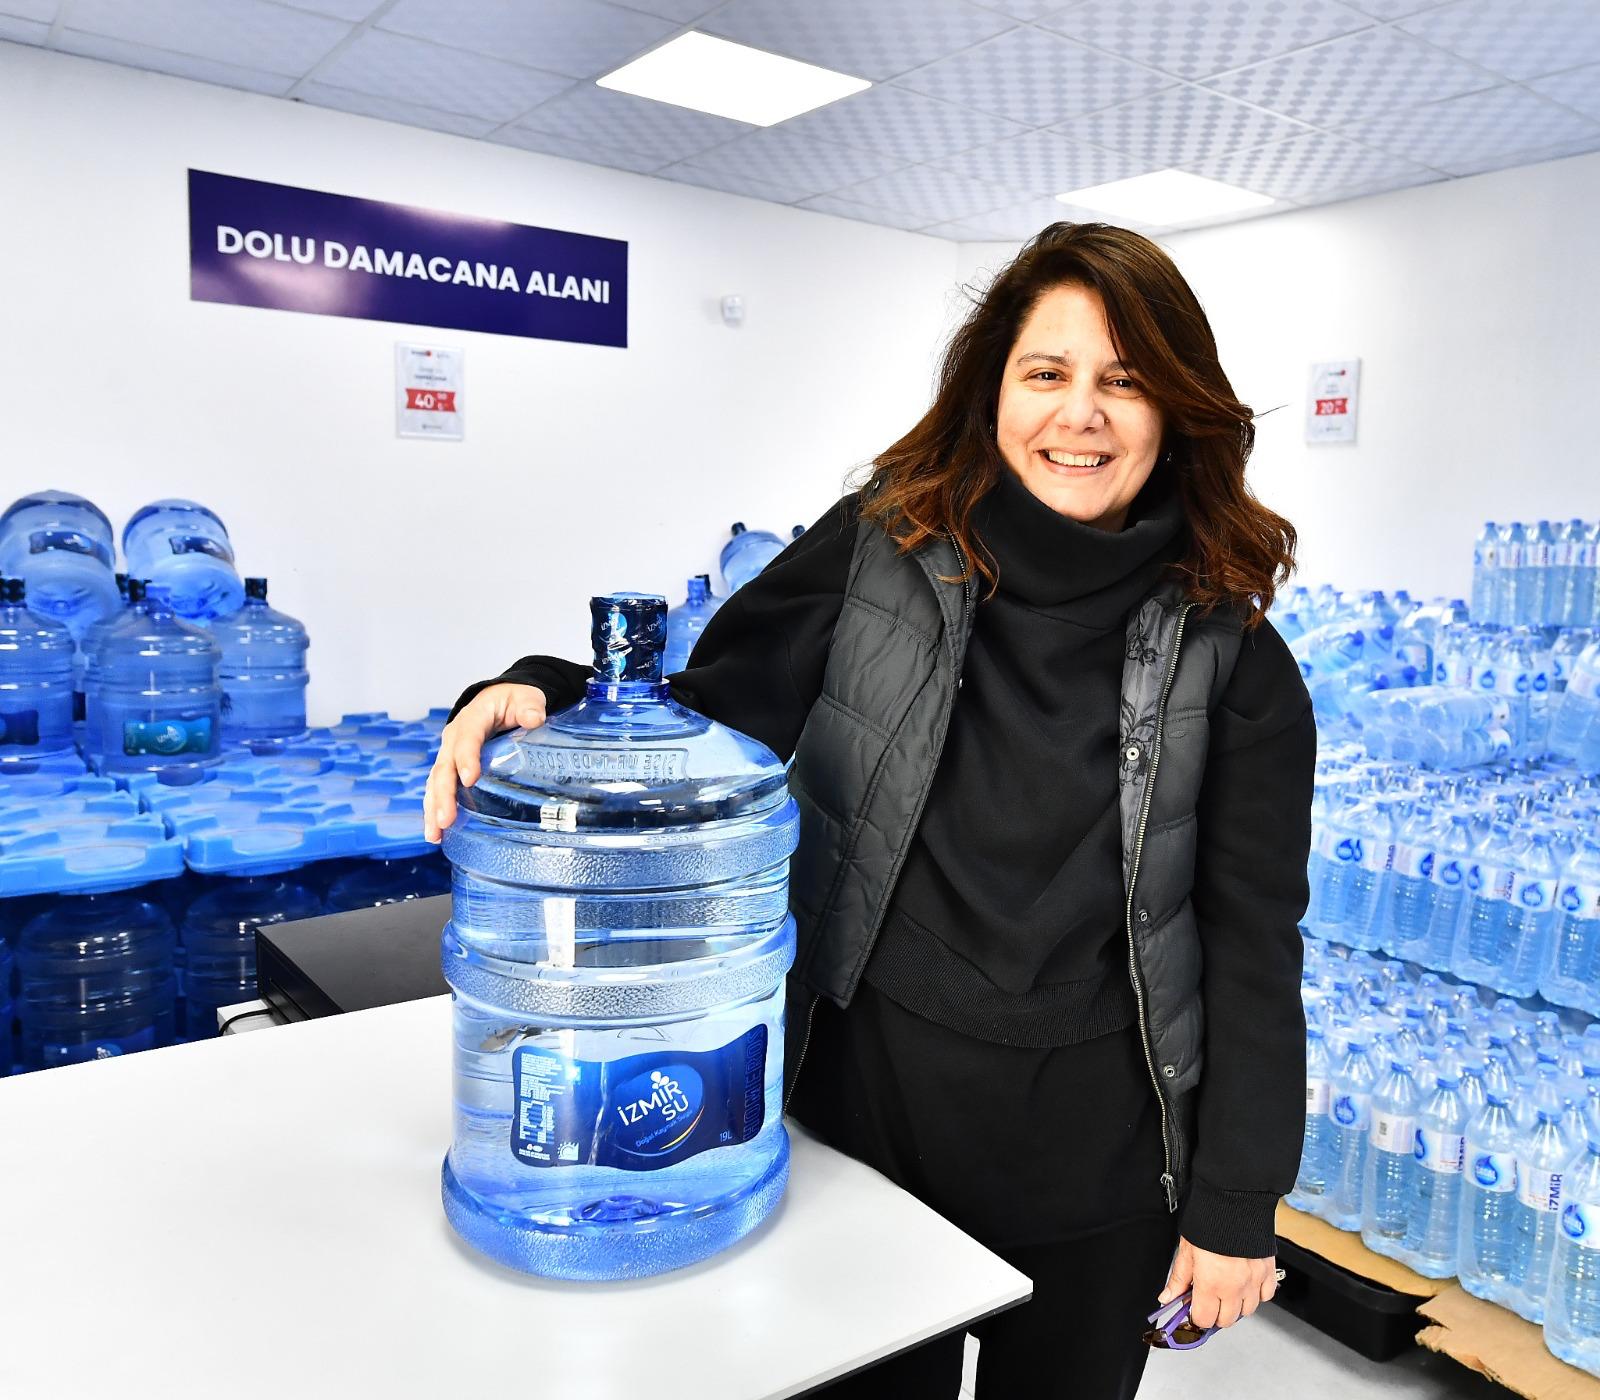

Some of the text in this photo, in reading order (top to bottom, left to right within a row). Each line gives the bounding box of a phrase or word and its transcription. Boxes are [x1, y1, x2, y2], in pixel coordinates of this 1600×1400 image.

[217, 225, 609, 304] DOLU DAMACANA ALANI
[415, 393, 435, 409] 40
[661, 1094, 689, 1121] SU
[720, 1129, 733, 1142] 19L
